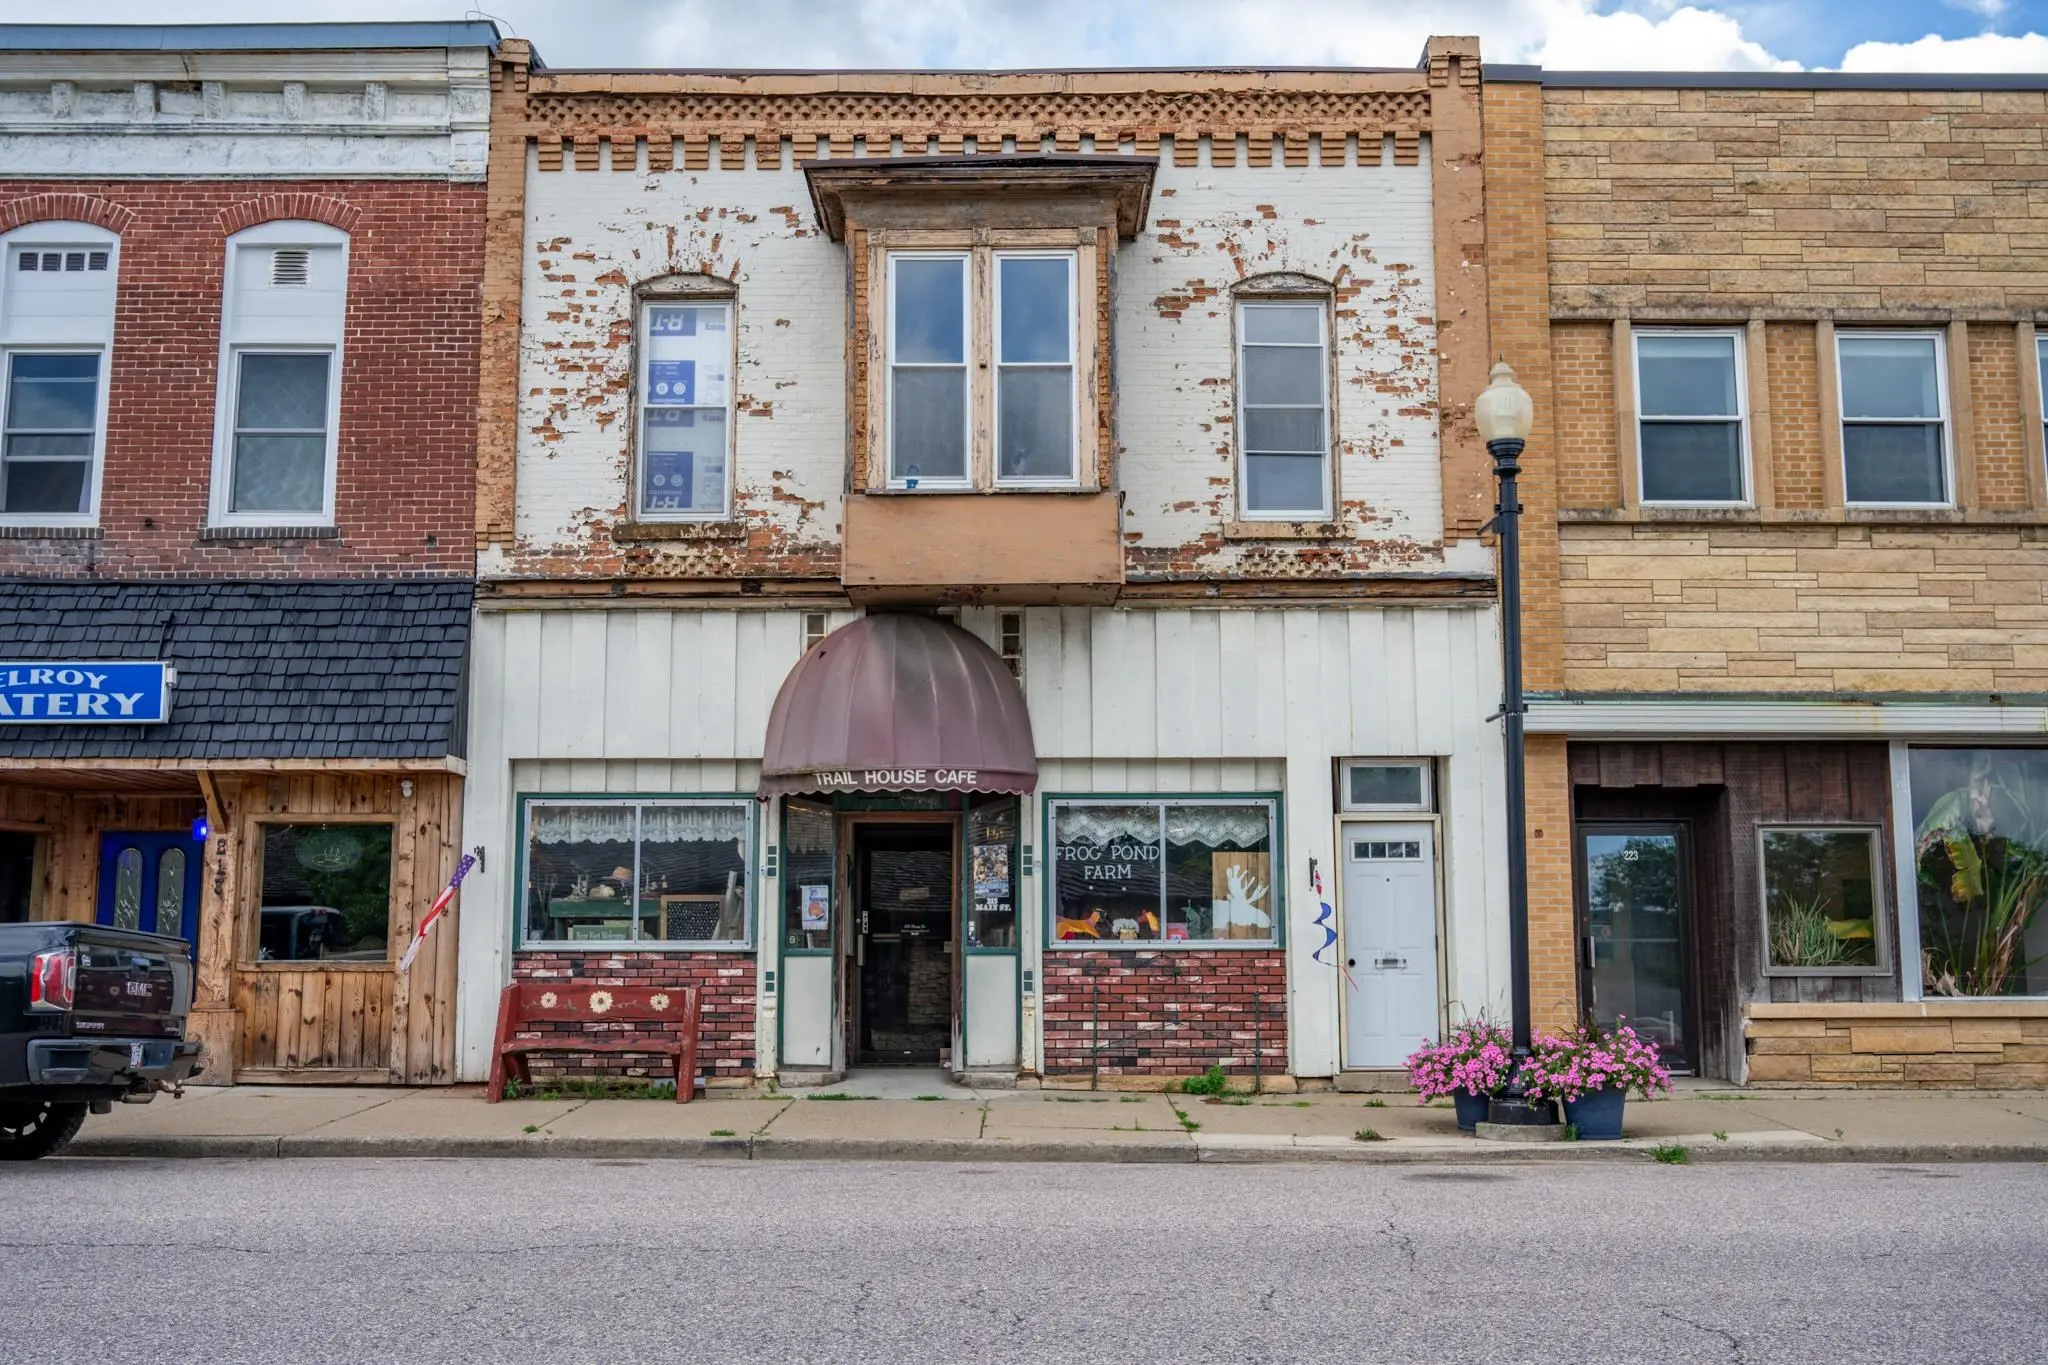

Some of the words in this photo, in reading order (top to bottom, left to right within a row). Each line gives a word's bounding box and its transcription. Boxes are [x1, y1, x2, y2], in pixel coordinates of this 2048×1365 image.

[813, 772, 858, 785] TRAIL
[865, 769, 926, 784] HOUSE
[935, 769, 977, 784] CAFE
[1055, 846, 1102, 860] FROG
[1111, 845, 1160, 860] POND
[1624, 850, 1639, 861] 223
[1084, 864, 1131, 879] FARM
[127, 981, 153, 997] GMC
